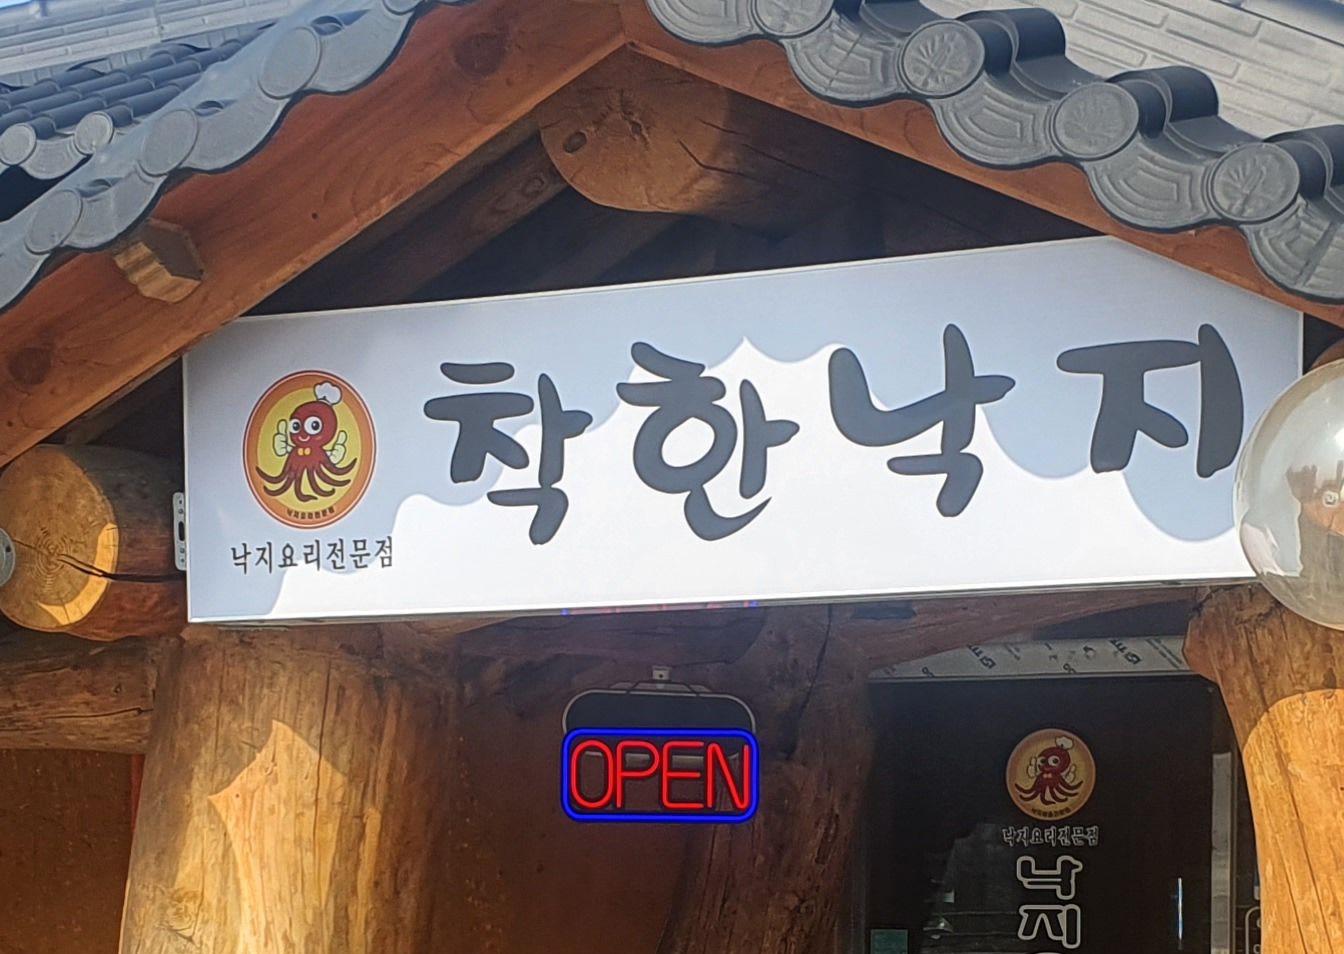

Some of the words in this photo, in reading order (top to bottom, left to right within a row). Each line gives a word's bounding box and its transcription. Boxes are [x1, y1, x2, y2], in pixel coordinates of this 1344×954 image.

[423, 323, 1245, 547] 착한낙지
[231, 535, 393, 575] 낙지요리전문점
[570, 739, 750, 809] OPEN
[1001, 825, 1100, 847] 낙지요리전문점
